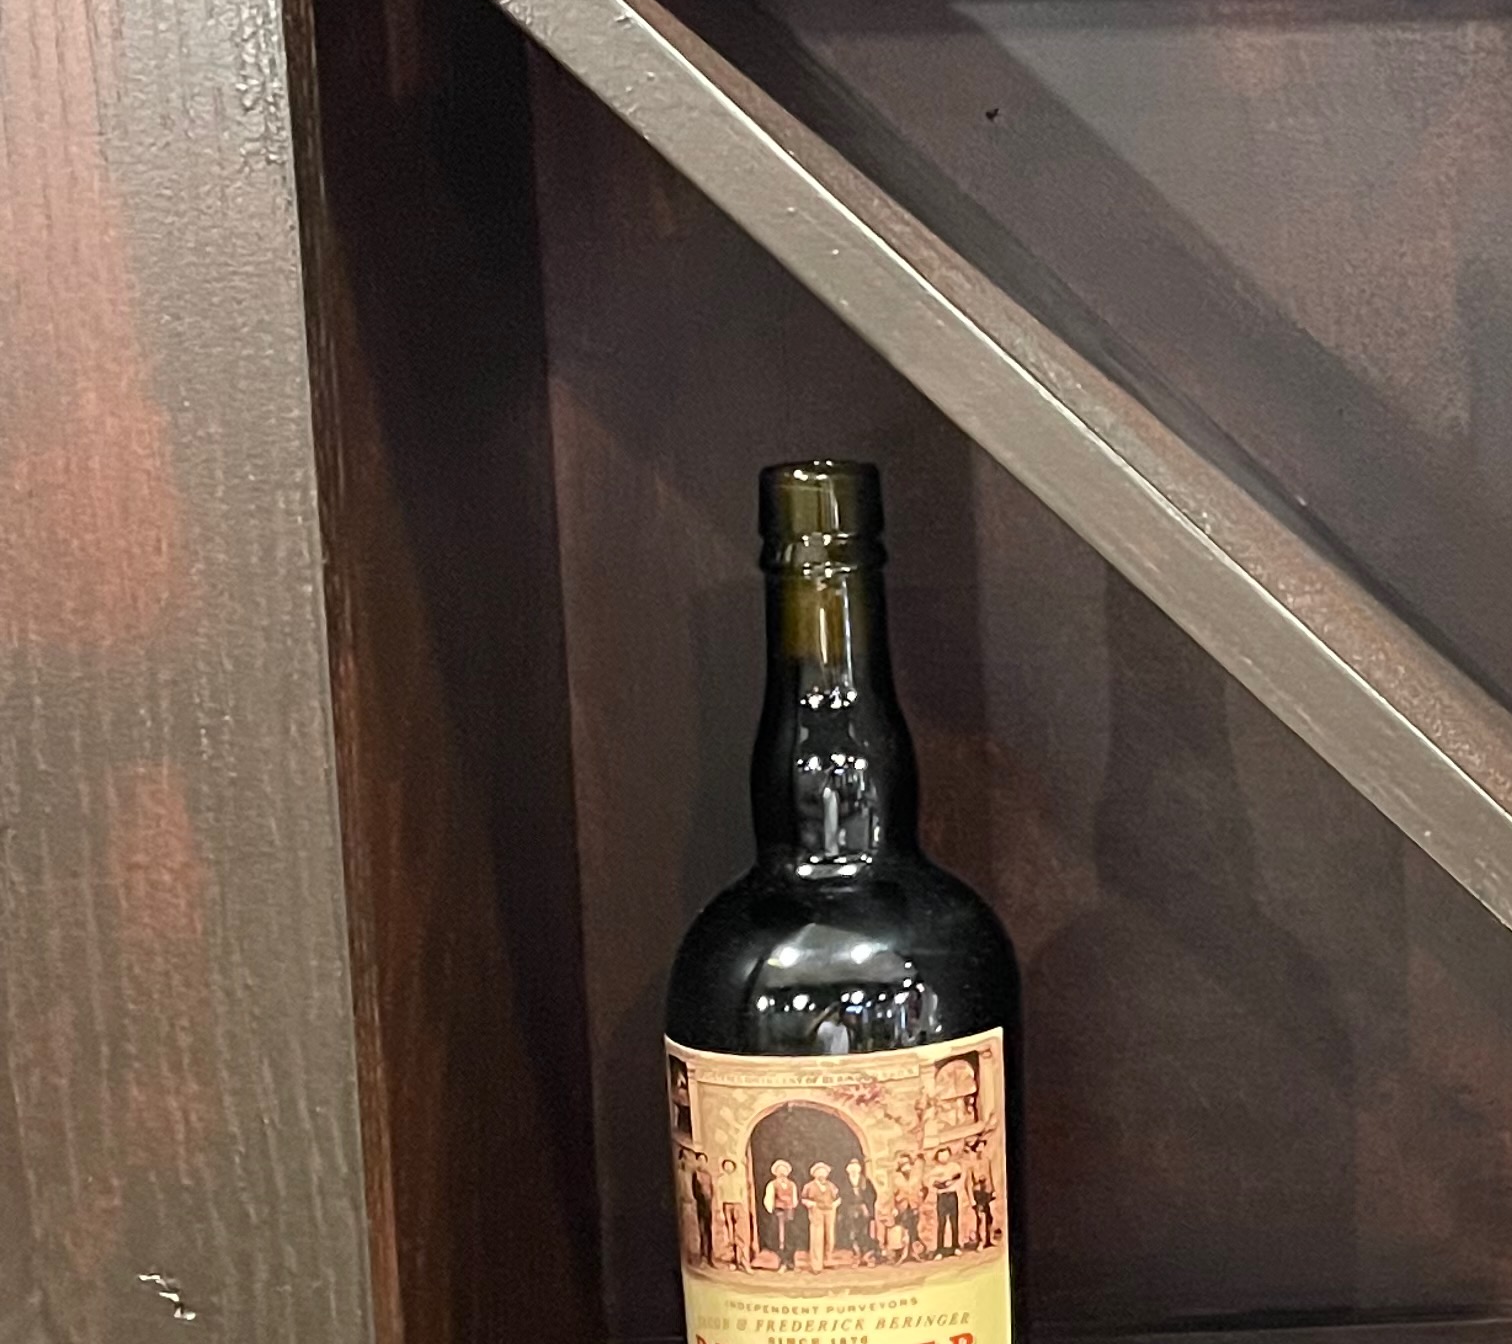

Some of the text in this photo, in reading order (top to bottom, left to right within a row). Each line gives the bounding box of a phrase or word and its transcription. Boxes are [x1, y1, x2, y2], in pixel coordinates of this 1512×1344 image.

[726, 1297, 918, 1315] INDEPENDENT PURVEYORS
[754, 1318, 865, 1332] FREDERICK
[875, 1311, 971, 1330] BERINGER
